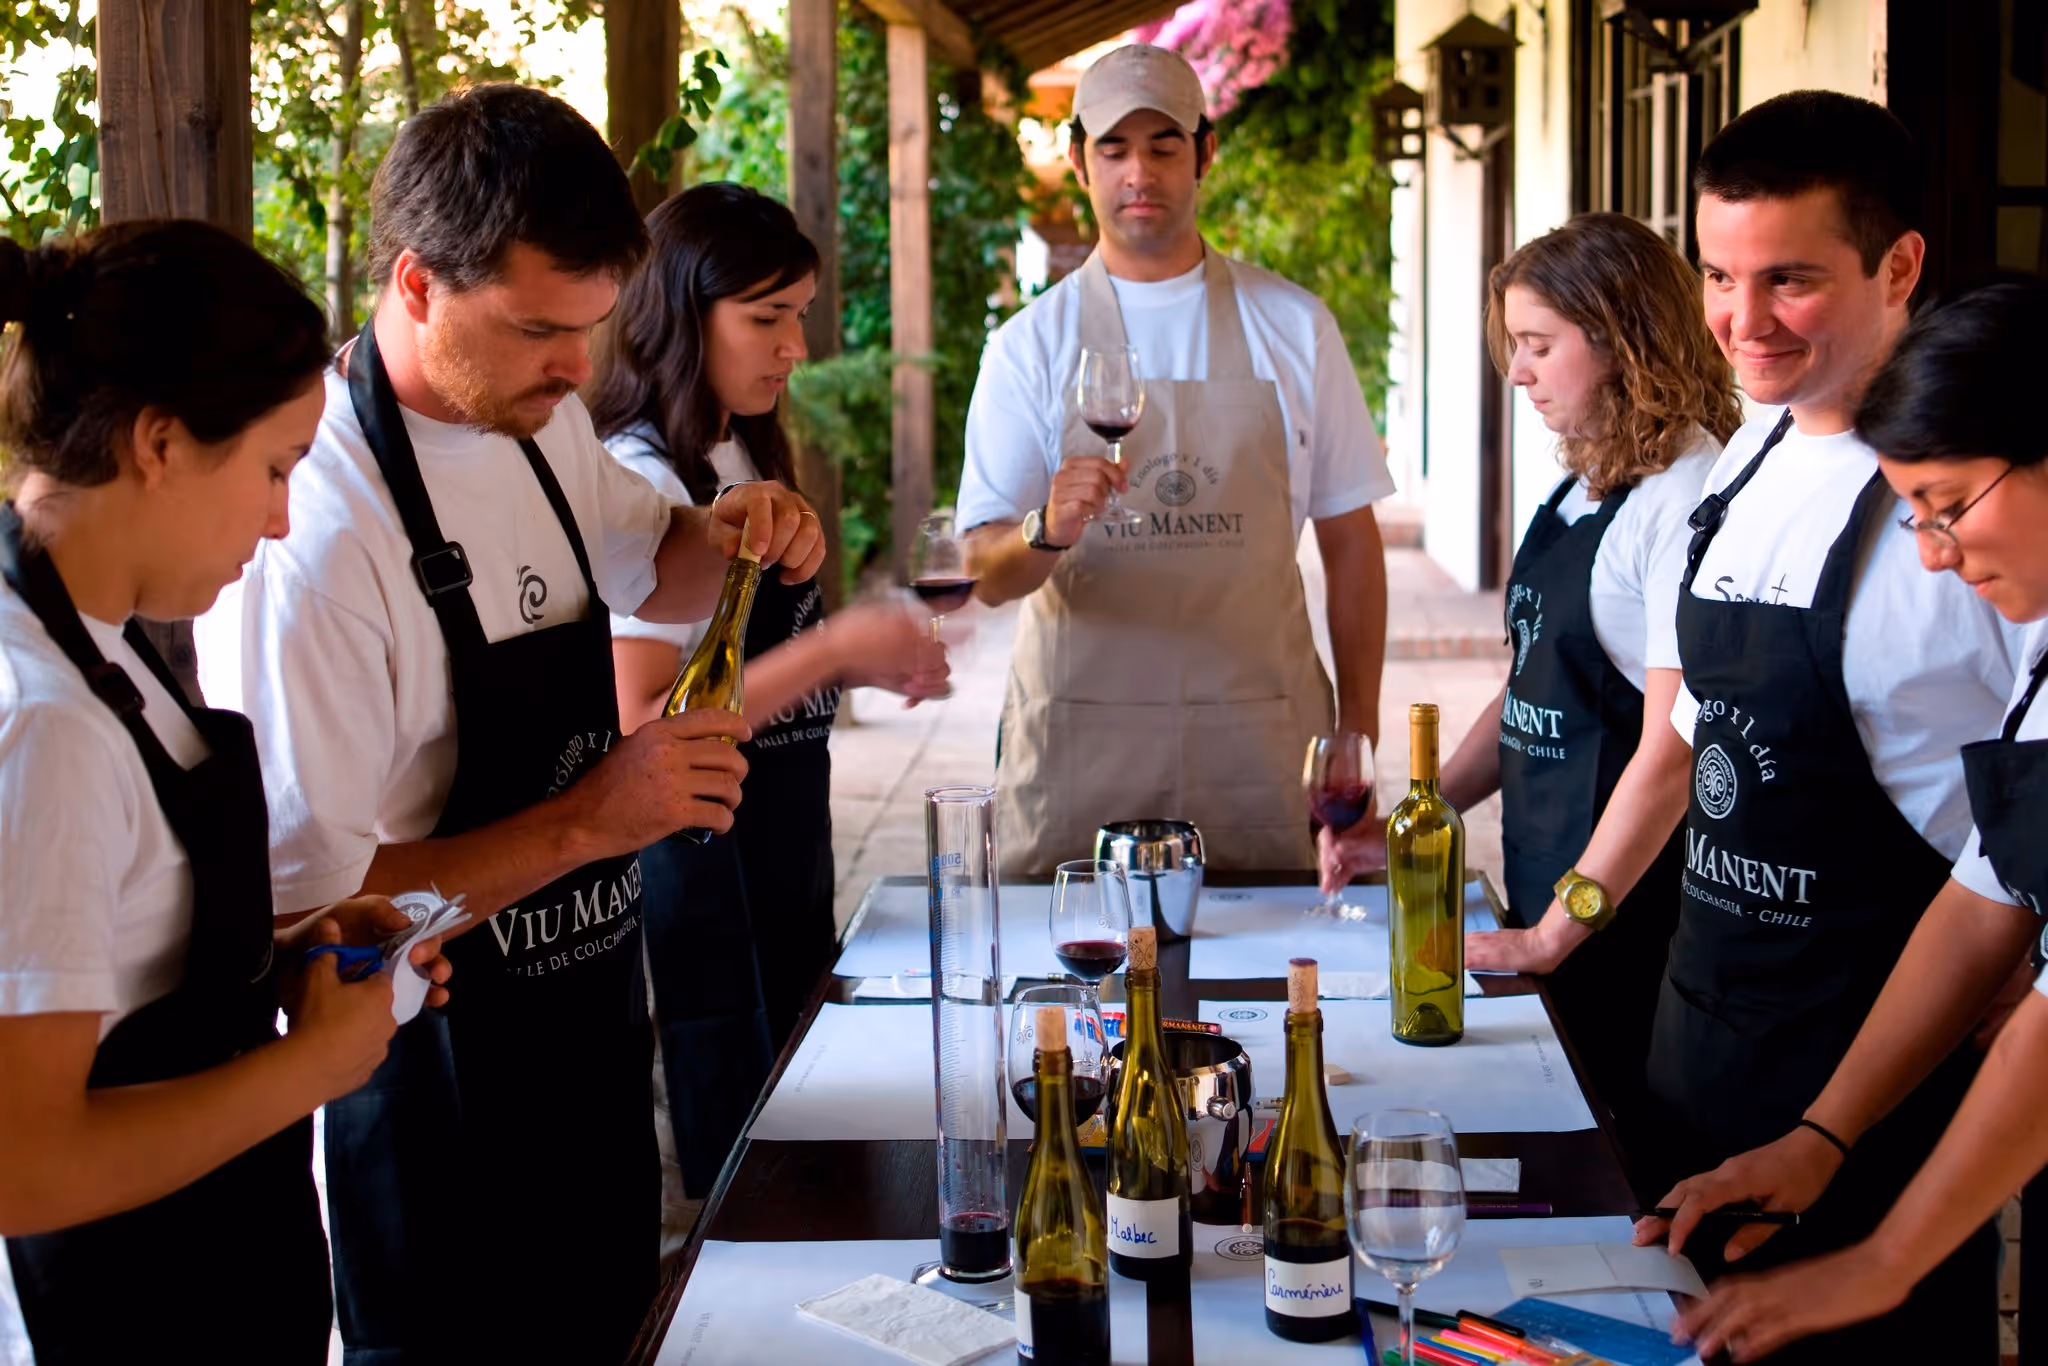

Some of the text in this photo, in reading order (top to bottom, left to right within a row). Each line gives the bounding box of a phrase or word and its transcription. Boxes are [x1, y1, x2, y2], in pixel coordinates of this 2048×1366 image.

[1150, 511, 1244, 536] MANENT
[1527, 744, 1566, 760] CHILE
[1687, 827, 1817, 904] MANENT
[1686, 881, 1743, 918] COLCHAGUA
[1759, 909, 1813, 928] CHILE
[488, 904, 564, 957] VIU
[549, 952, 570, 971] DE
[1110, 1213, 1157, 1244] Malbec
